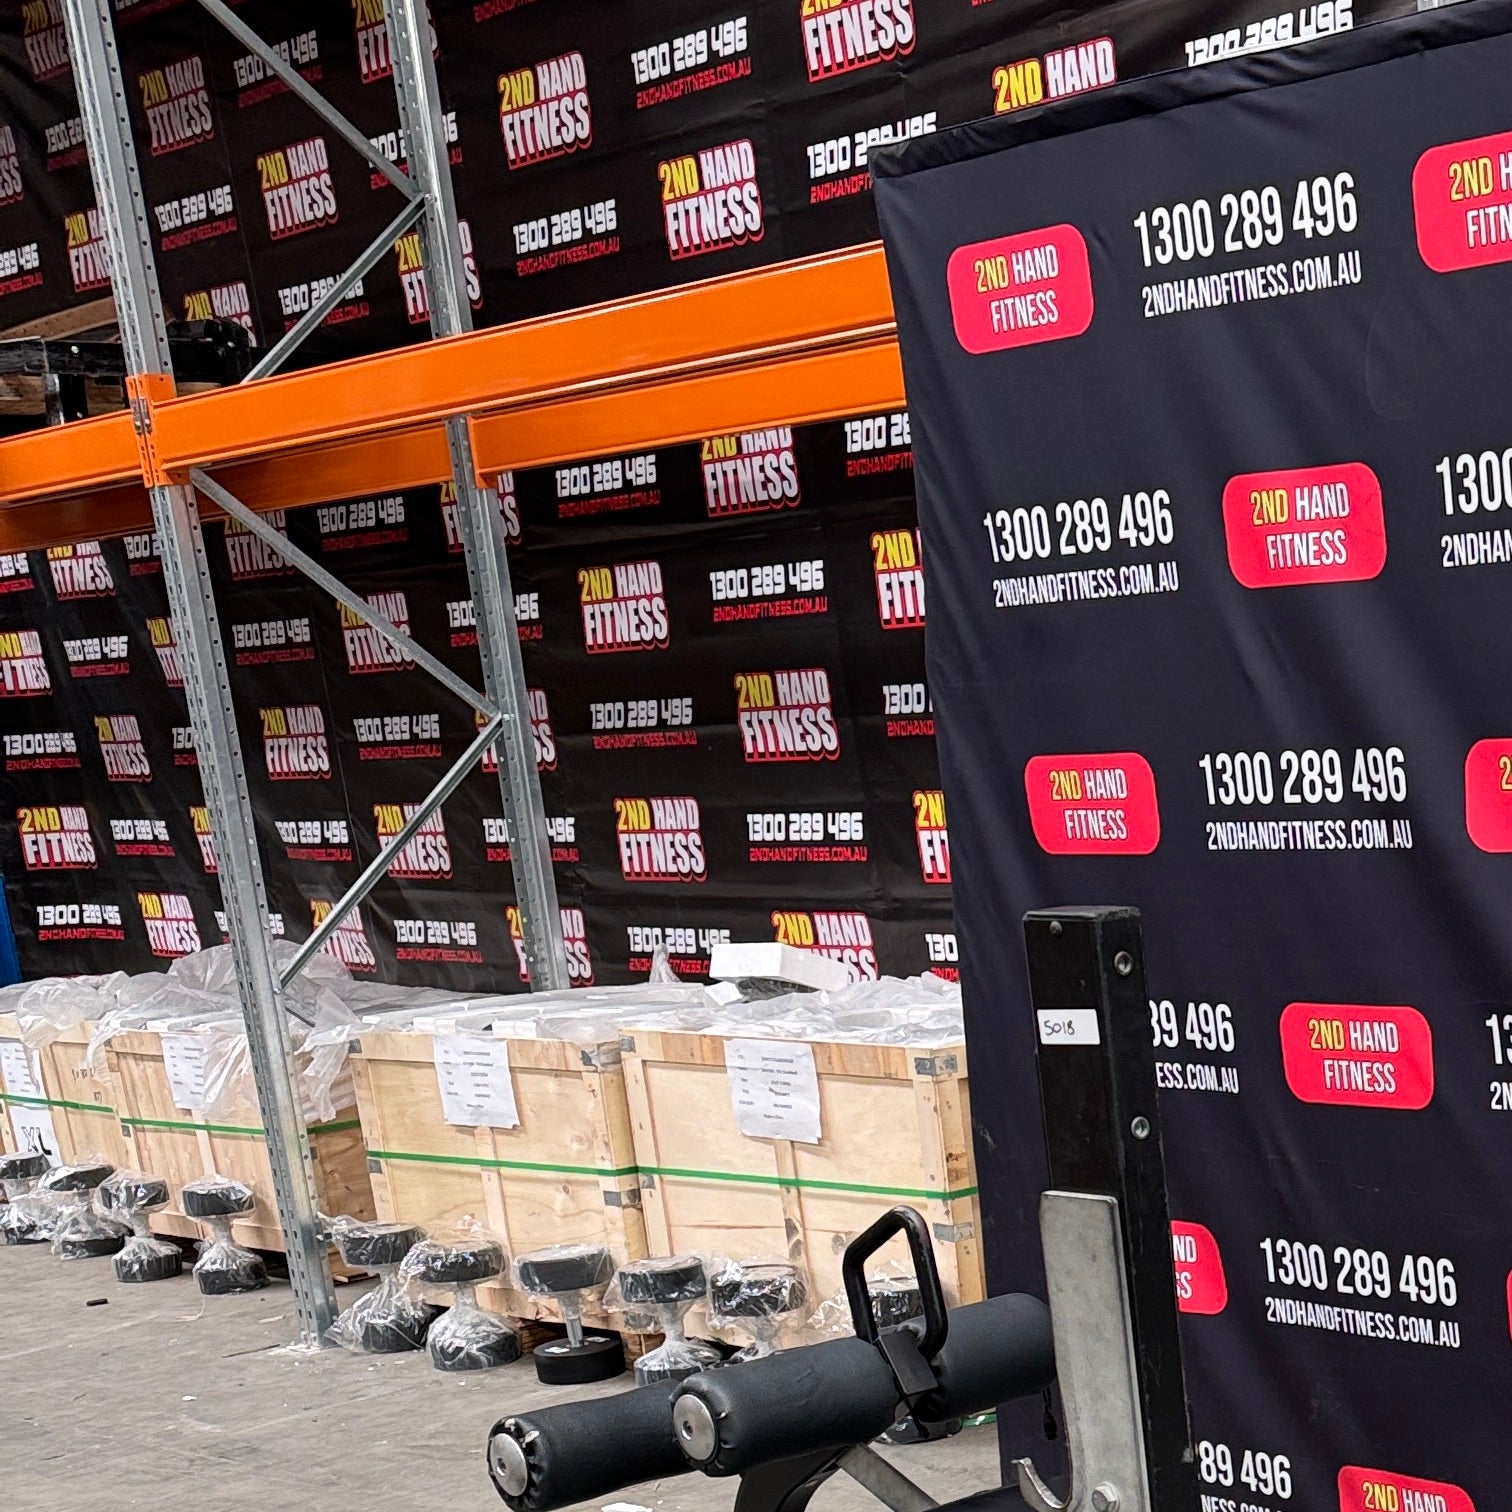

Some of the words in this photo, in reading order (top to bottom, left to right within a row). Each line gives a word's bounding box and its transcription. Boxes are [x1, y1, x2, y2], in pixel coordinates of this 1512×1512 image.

[630, 42, 671, 85] 1300
[672, 29, 708, 72] 289
[710, 16, 748, 58] 496
[802, 0, 914, 71] FITNESS
[499, 70, 535, 113] 2ND
[536, 53, 586, 101] HAND
[994, 60, 1043, 112] 2ND
[1045, 40, 1116, 98] HAND
[501, 91, 590, 160] FITNESS
[257, 151, 289, 190] 2ND
[286, 138, 329, 180] HAND
[659, 157, 700, 201] 2ND
[699, 141, 756, 190] HAND
[1449, 157, 1494, 201] 2ND
[263, 172, 337, 232] FITNESS
[665, 181, 761, 251] FITNESS
[1133, 199, 1215, 267] 1300
[1220, 186, 1284, 253] 289
[1292, 171, 1358, 239] 496
[512, 217, 549, 255] 1300
[550, 208, 583, 246] 289
[583, 198, 617, 235] 496
[974, 255, 1009, 293] 2ND
[1011, 244, 1059, 285] HAND
[1141, 249, 1362, 318] 2NDHANDFITNESS.COM.AU
[990, 289, 1059, 333] FITNESS
[555, 465, 591, 498] 1300
[592, 460, 623, 493] 289
[624, 454, 657, 487] 496
[983, 505, 1052, 563] 1300
[1055, 497, 1112, 556] 289
[1118, 489, 1174, 548] 496
[1250, 488, 1289, 526] 2ND
[1295, 482, 1350, 521] HAND
[1266, 529, 1347, 569] FITNESS
[578, 567, 614, 602] 2ND
[614, 561, 663, 598] HAND
[709, 568, 749, 601] 1300
[750, 564, 786, 597] 289
[787, 559, 825, 592] 496
[992, 560, 1179, 608] 2NDHANDFITNESS.COM.AU
[583, 596, 668, 646] FITNESS
[735, 674, 775, 709] 2ND
[775, 670, 831, 707] HAND
[259, 708, 287, 737] 2ND
[285, 706, 325, 735] HAND
[739, 706, 838, 754] FITNESS
[265, 735, 330, 773] FITNESS
[1198, 751, 1274, 806] 1300
[1279, 748, 1344, 804] 289
[1351, 746, 1407, 802] 496
[1049, 770, 1082, 801] 2ND
[1083, 768, 1128, 800] HAND
[18, 807, 61, 833] 2ND
[59, 806, 89, 831] HAND
[615, 799, 651, 831] 2ND
[650, 798, 700, 830] HAND
[746, 813, 786, 842] 1300
[789, 812, 824, 841] 289
[827, 811, 864, 841] 496
[1064, 809, 1127, 840] FITNESS
[1205, 819, 1413, 850] 2NDHANDFITNESS.COM.AU
[22, 831, 96, 865] FITNESS
[618, 831, 705, 874] FITNESS
[1044, 1020, 1074, 1035] 5018
[1185, 1002, 1235, 1053] 496
[1308, 1018, 1345, 1050] 2ND
[1348, 1020, 1399, 1053] HAND
[1323, 1059, 1396, 1093] FITNESS
[1259, 1237, 1328, 1291] 1300
[1333, 1246, 1392, 1299] 289
[1399, 1254, 1457, 1307] 496
[1264, 1296, 1461, 1349] 2NDHANDFITNESS.COM.AU
[1198, 1440, 1234, 1487] 89
[1240, 1449, 1292, 1499] 496
[1362, 1481, 1399, 1512] 2ND
